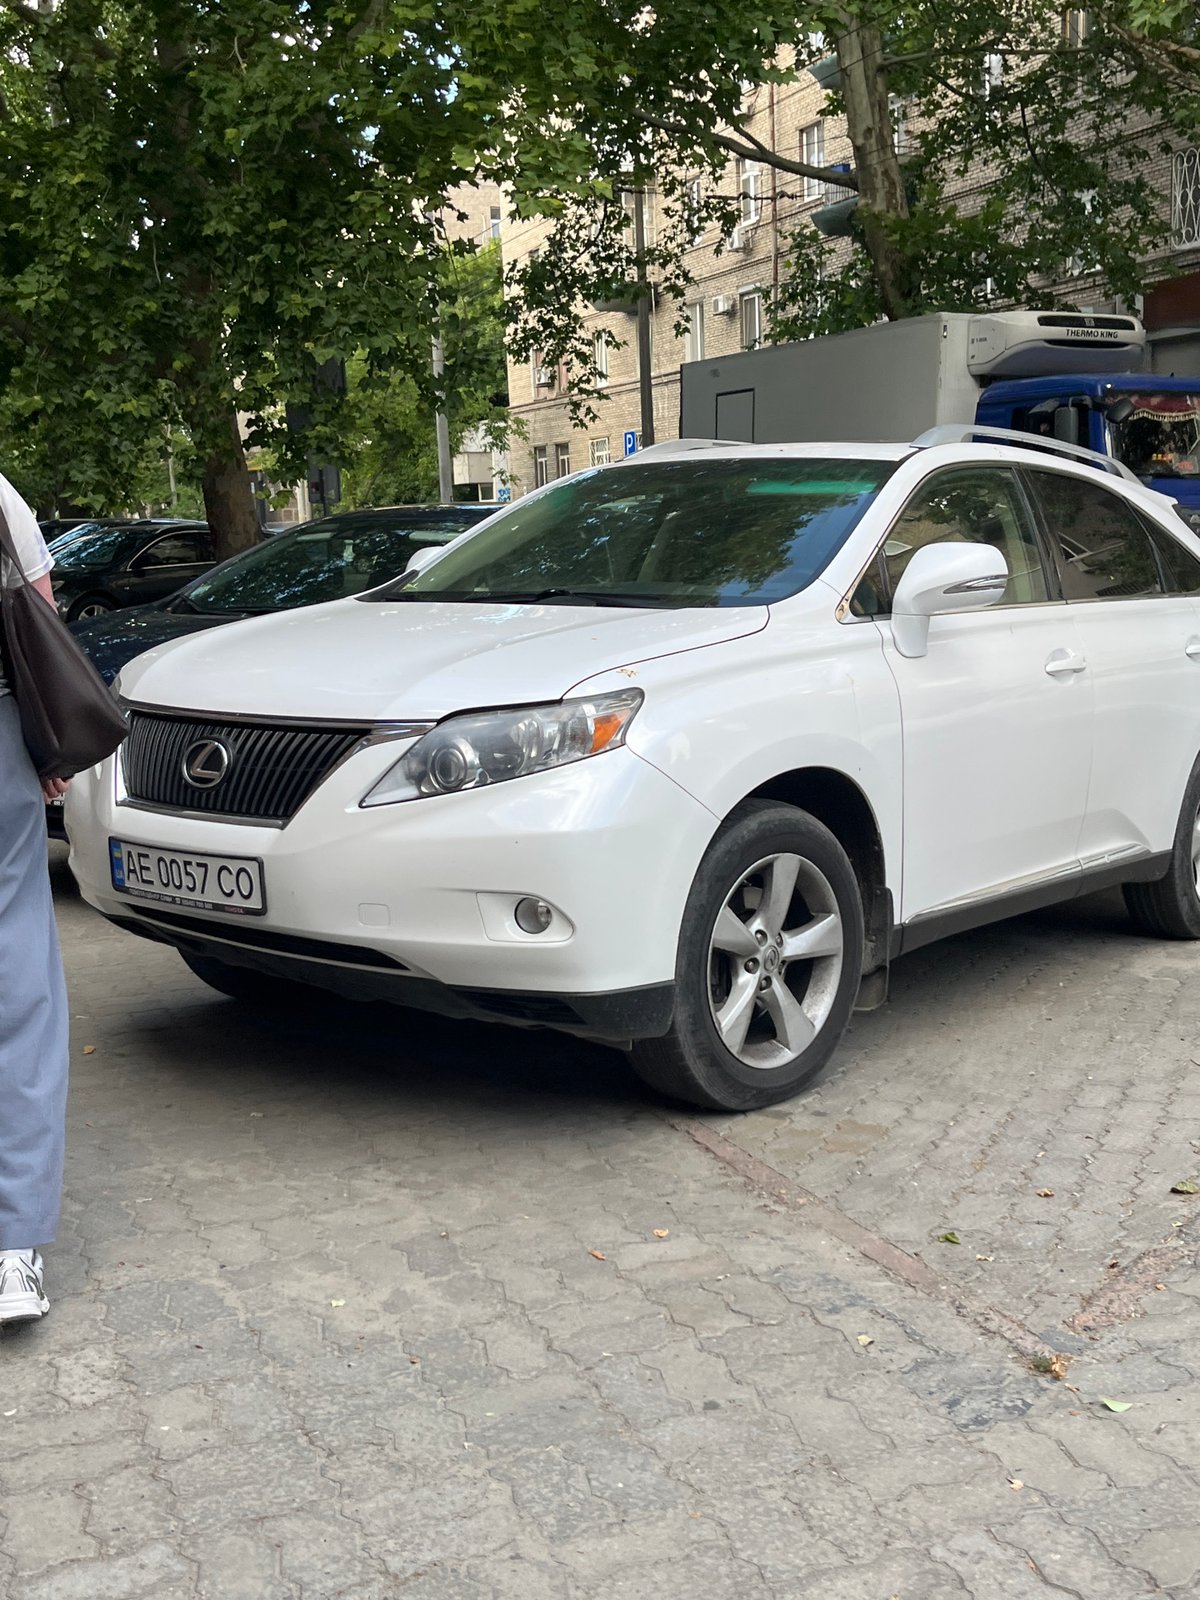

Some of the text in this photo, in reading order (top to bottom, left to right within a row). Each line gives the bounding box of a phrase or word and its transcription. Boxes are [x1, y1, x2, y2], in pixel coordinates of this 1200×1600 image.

[1066, 328, 1119, 339] THERMO KING
[626, 434, 634, 455] P
[127, 850, 154, 885] AE
[157, 856, 208, 894] 0057
[217, 865, 254, 900] CO
